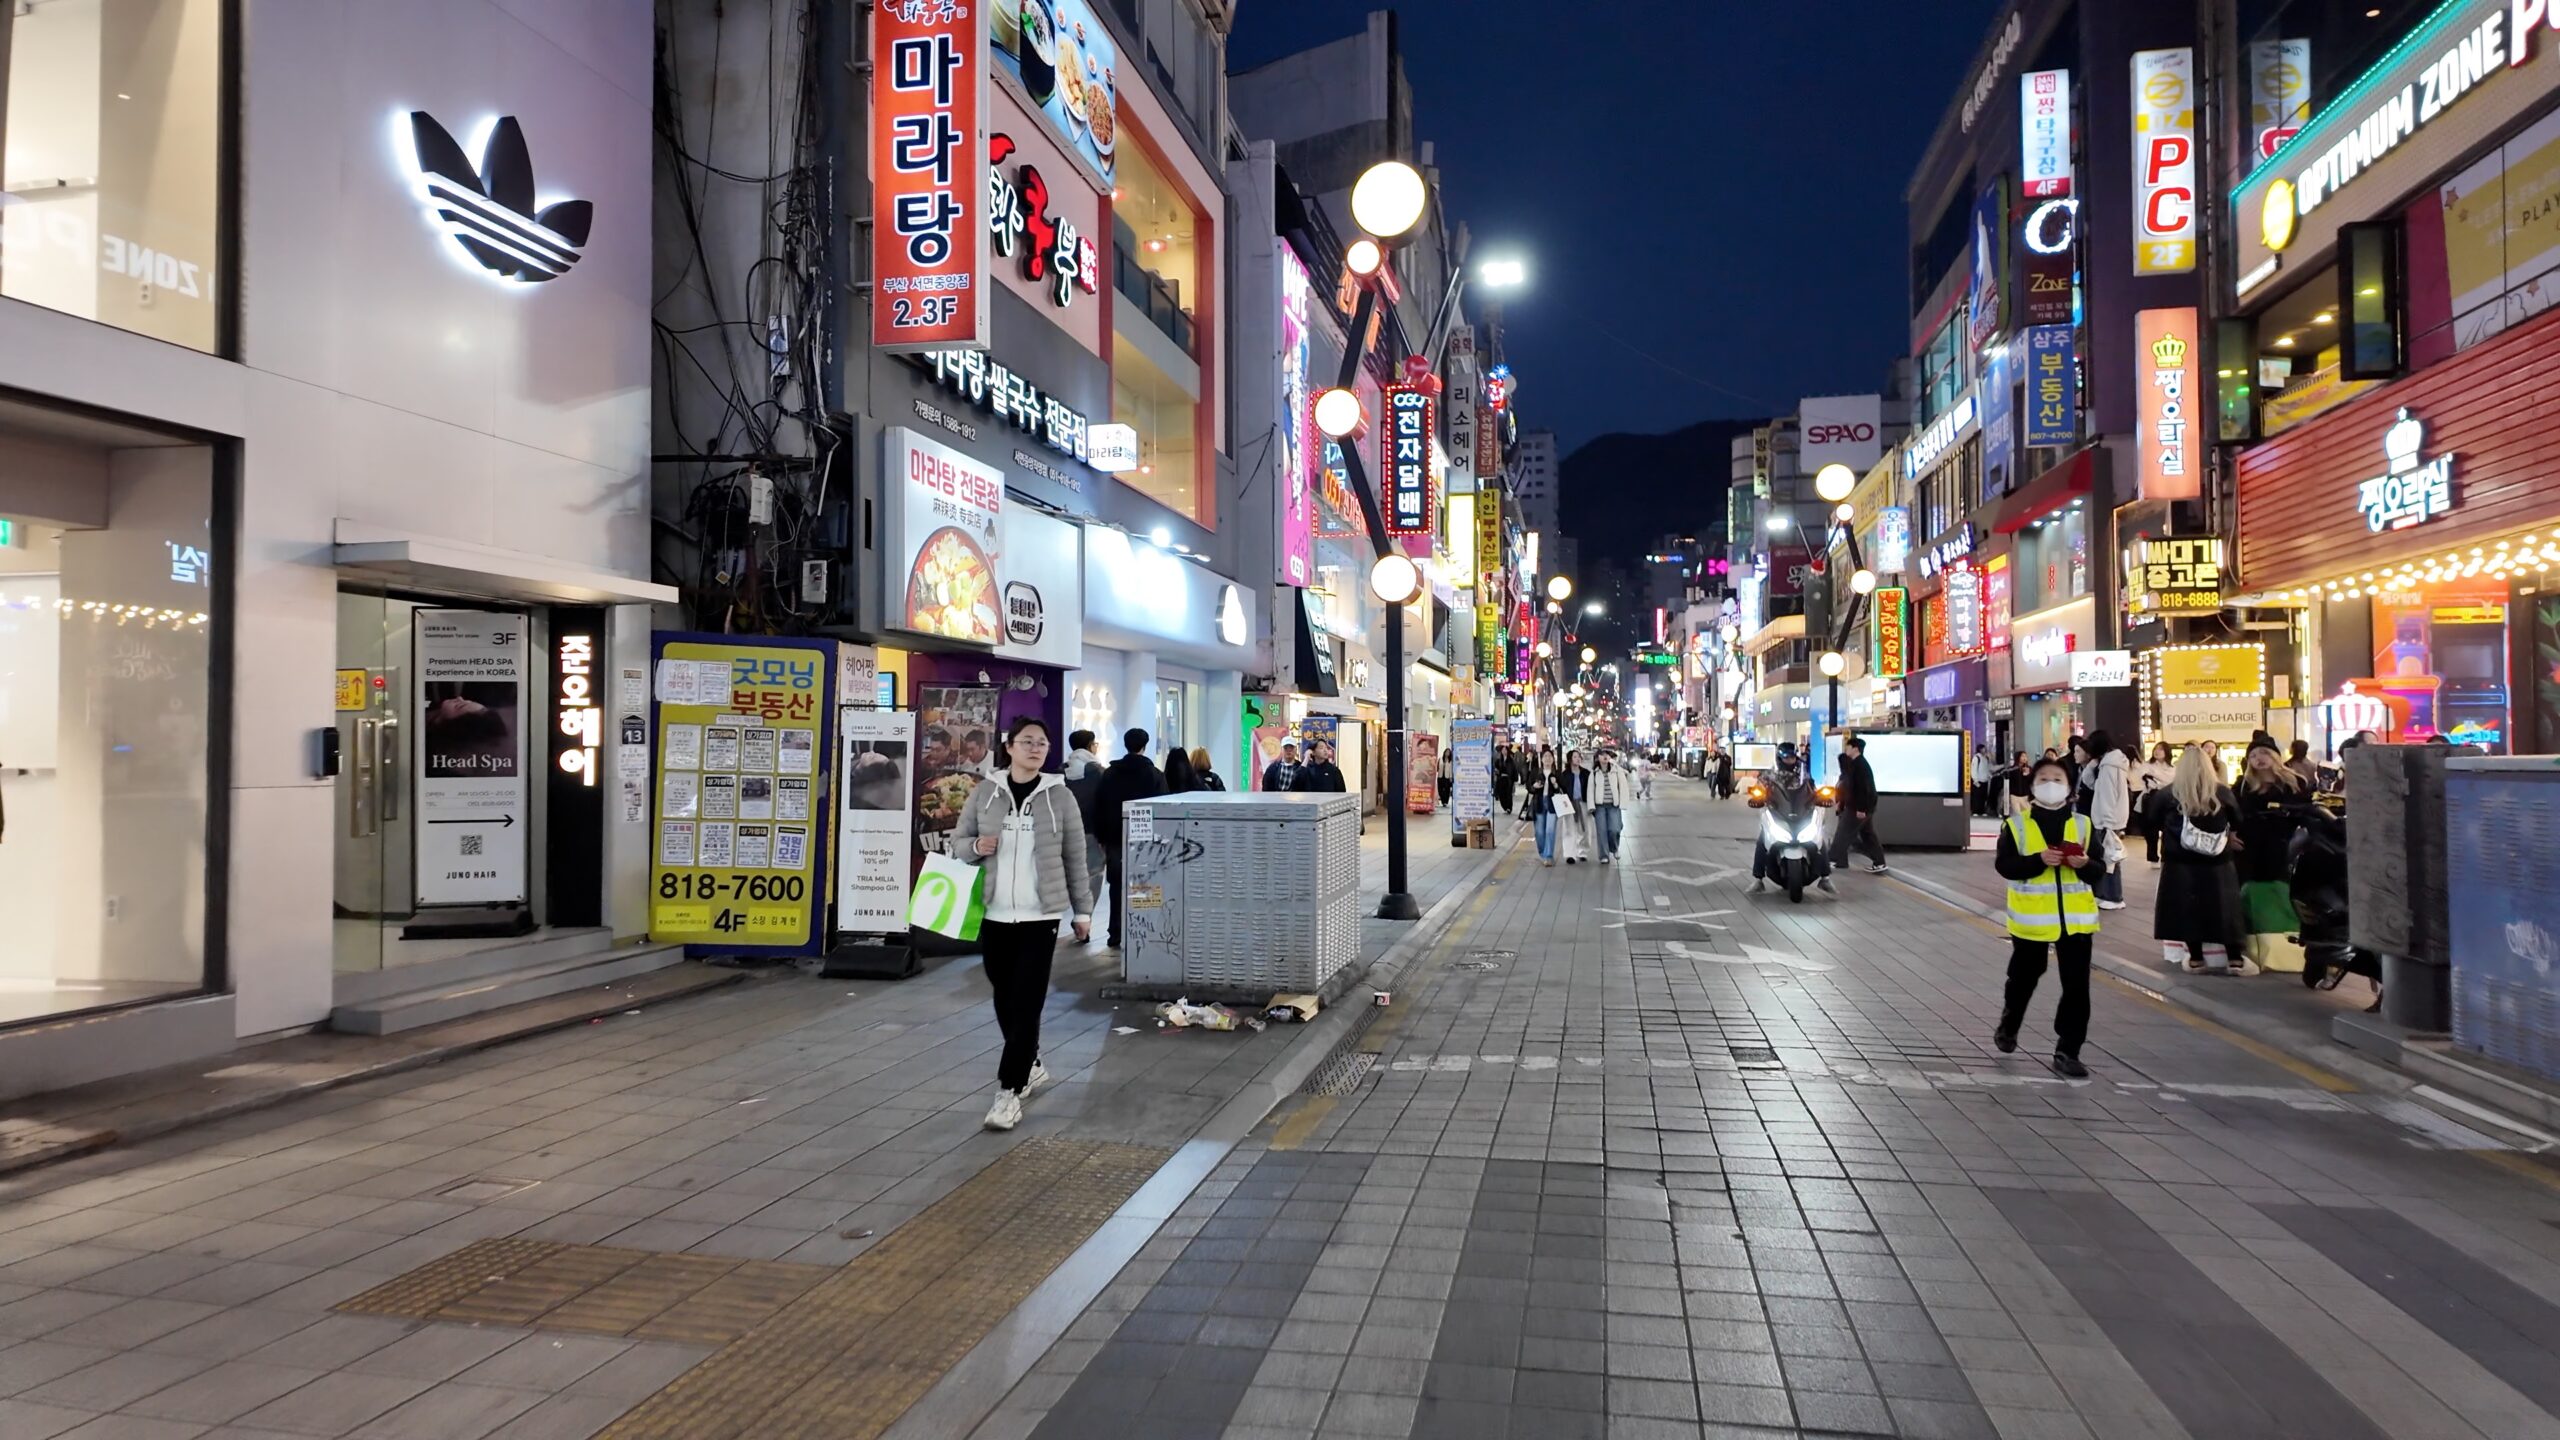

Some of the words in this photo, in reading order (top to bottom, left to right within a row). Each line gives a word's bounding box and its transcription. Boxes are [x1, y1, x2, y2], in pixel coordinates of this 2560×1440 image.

[2297, 83, 2414, 216] OPTIMUM
[2420, 10, 2505, 122] ZONE
[2510, 0, 2560, 67] P
[892, 34, 963, 268] 마라탕
[2035, 179, 2059, 195] 4F
[2145, 133, 2193, 236] PC
[2150, 244, 2185, 267] 2F
[884, 277, 909, 293] 부산
[910, 273, 970, 291] 서면중앙점
[893, 297, 957, 328] 2.3F
[2032, 330, 2071, 349] 삼주
[2039, 352, 2065, 427] 부동산
[914, 399, 942, 428] 가맹문의
[942, 409, 977, 442] 1588-1912
[1044, 396, 1087, 462] 전문점
[1452, 386, 1471, 473] 리소헤어
[1807, 422, 1874, 444] SPAO
[1088, 446, 1123, 459] 마라탕
[1398, 411, 1422, 514] 전자담배
[910, 447, 956, 497] 마라탕
[960, 468, 1000, 514] 전문점
[932, 497, 959, 522] 麻辣烫
[958, 506, 982, 529] 专卖店
[2146, 563, 2219, 588] 중고폰
[2161, 591, 2219, 608] 818-6888
[492, 632, 518, 646] 3F
[426, 668, 475, 677] Experience
[476, 668, 485, 676] in
[486, 668, 517, 676] KOREA
[428, 657, 468, 666] Premium
[469, 658, 495, 666] HEAD
[496, 658, 514, 666] SPA
[845, 657, 875, 679] 헤어짱
[732, 658, 815, 690] 굿모닝
[559, 634, 601, 787] 준오헤어
[731, 690, 814, 721] 부동산
[2166, 714, 2197, 724] FOOD
[2209, 712, 2257, 723] CHARGE
[625, 729, 642, 743] 13
[892, 727, 908, 736] 3F
[432, 754, 477, 768] Head
[481, 754, 513, 771] Spa
[780, 835, 802, 849] 직원
[779, 849, 801, 861] 모집
[880, 849, 894, 858] Spa
[446, 872, 471, 880] JUNO
[659, 872, 804, 901] 818-7600
[851, 884, 885, 893] Shampoo
[886, 883, 900, 891] Gift
[713, 908, 747, 933] 4F
[752, 916, 766, 925] 소장
[854, 909, 874, 917] JUNO
[876, 909, 895, 917] HAIR
